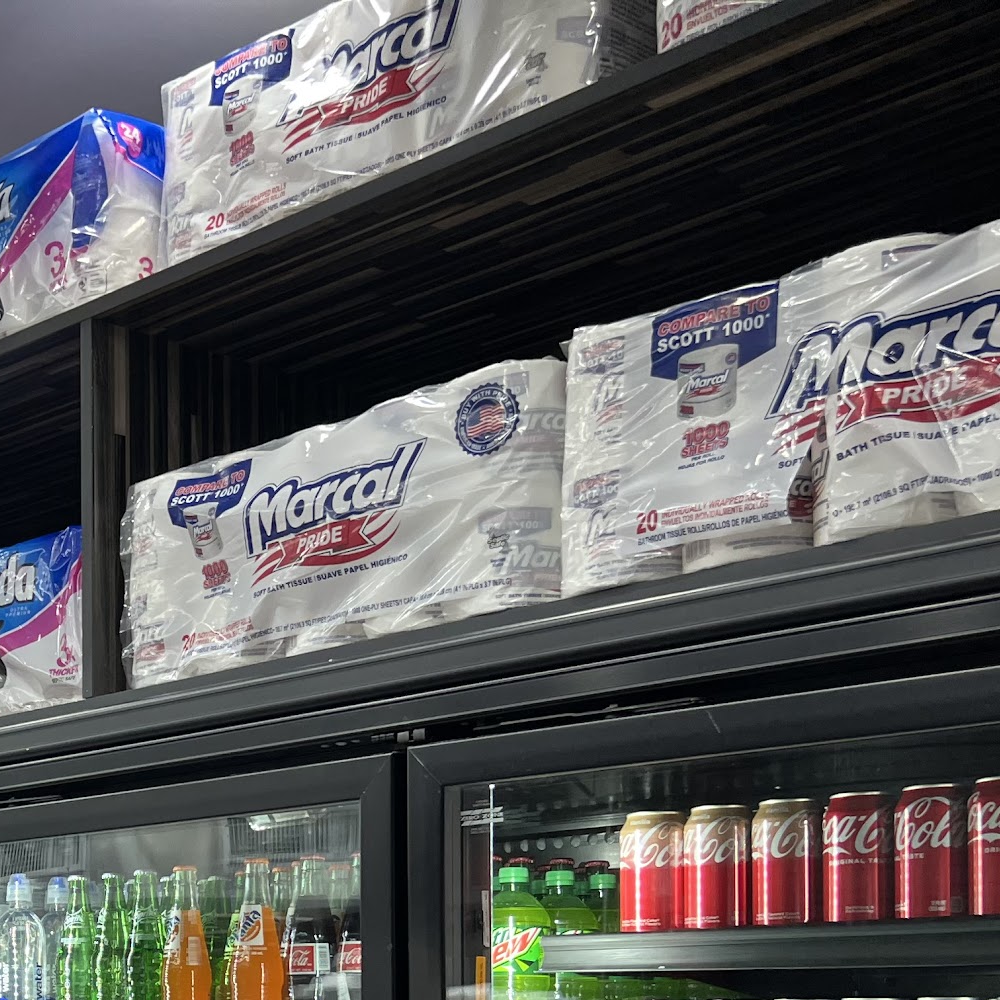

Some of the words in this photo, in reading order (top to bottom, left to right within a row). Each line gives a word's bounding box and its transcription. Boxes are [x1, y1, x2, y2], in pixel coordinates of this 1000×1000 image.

[271, 37, 289, 52] TO
[662, 12, 683, 50] 20
[214, 63, 247, 89] SCOTT
[341, 79, 389, 115] PRIDE
[285, 152, 303, 164] SOFT
[304, 144, 325, 157] BATH
[357, 124, 380, 139] SUAVE
[380, 112, 404, 129] PAPEL
[204, 212, 225, 232] 20
[657, 304, 741, 337] COMPARE
[745, 295, 770, 315] TO
[656, 326, 715, 353] SCOTT
[722, 314, 766, 337] 1000
[687, 369, 730, 393] Marcal
[881, 367, 968, 406] PRIDE
[682, 420, 731, 446] 1000
[680, 437, 729, 460] SHEETS
[778, 456, 805, 470] SOFT
[836, 442, 869, 462] BATH
[170, 490, 212, 507] SCOTT
[214, 484, 241, 499] 1000
[174, 478, 229, 496] COMPARE
[230, 469, 246, 484] TO
[243, 436, 428, 560] Marcal
[636, 509, 658, 535] 20
[709, 496, 745, 512] WRAPPED
[667, 528, 687, 540] TISSUE
[731, 518, 740, 527] DE
[741, 515, 761, 527] PAPEL
[297, 525, 344, 554] PRIDE
[202, 559, 229, 581] 1000
[286, 576, 313, 588] TISSUE
[316, 570, 343, 582] SUAVE
[344, 564, 369, 576] PAPEL
